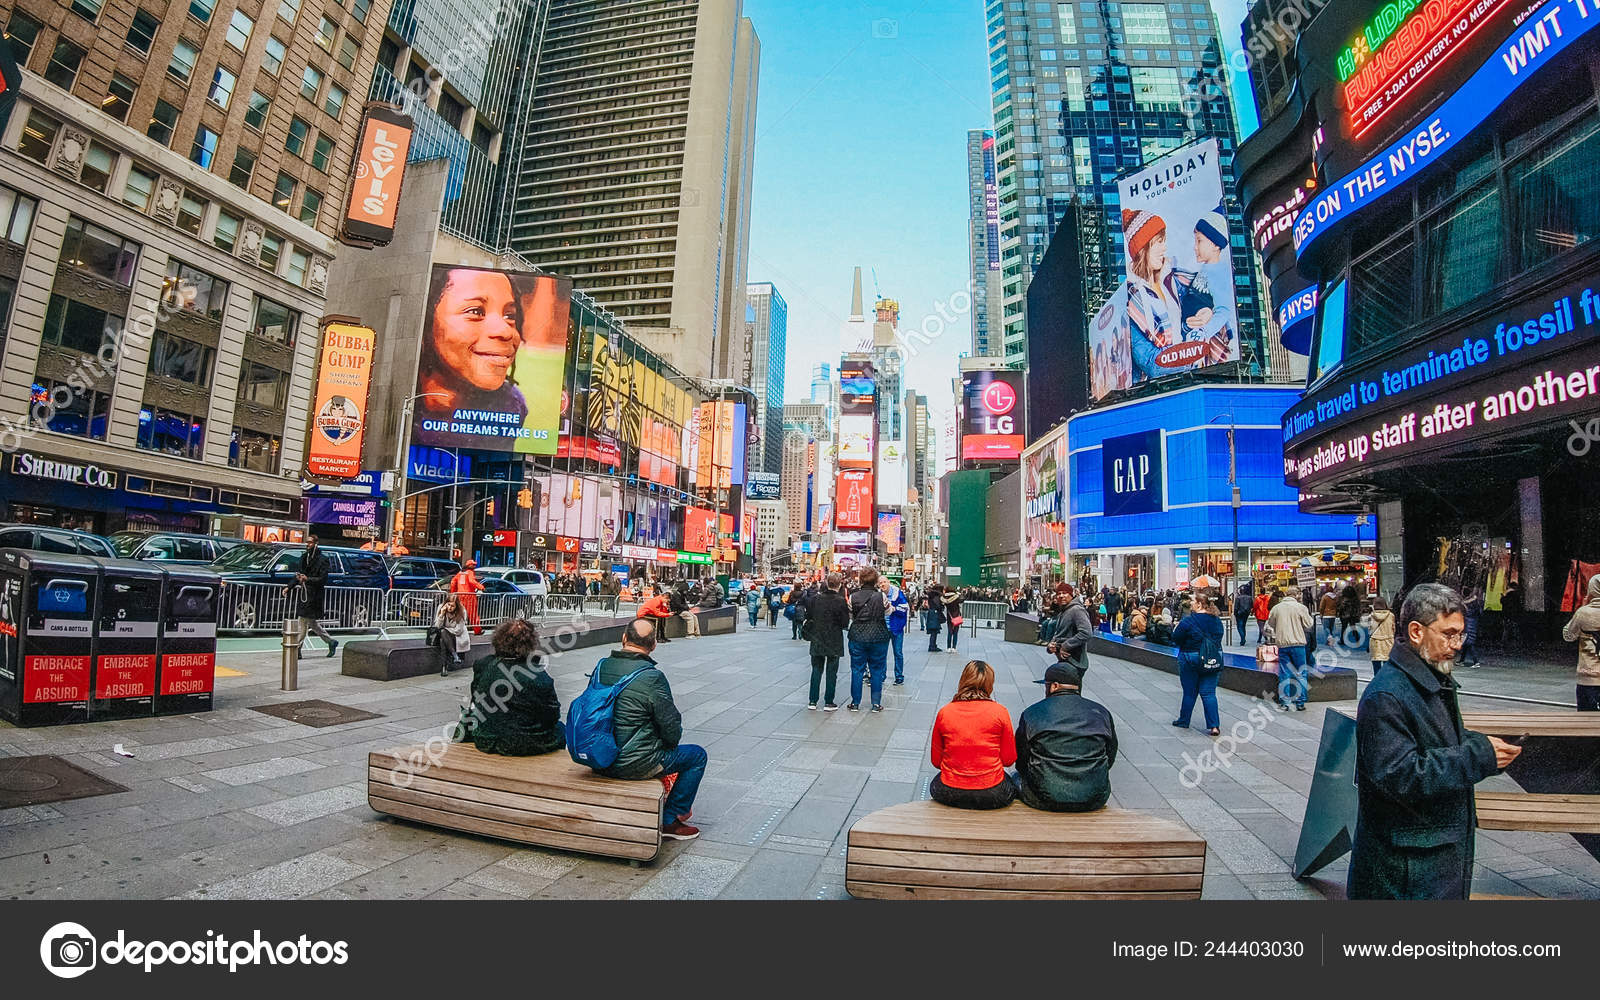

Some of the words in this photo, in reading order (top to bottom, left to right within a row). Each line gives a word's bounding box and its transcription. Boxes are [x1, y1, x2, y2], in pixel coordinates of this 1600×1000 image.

[1501, 6, 1562, 76] WMT
[1363, 97, 1384, 122] FREE
[1385, 74, 1409, 101] 2-DAY
[1409, 35, 1453, 78] DELIVERY.
[1452, 19, 1468, 39] NO
[1129, 152, 1208, 198] HOLIDAY
[1317, 190, 1341, 223] ON
[1343, 162, 1387, 204] THE
[1389, 118, 1451, 179] NYSE.
[1146, 188, 1167, 201] YOUR
[1177, 176, 1193, 191] OUT
[327, 331, 370, 351] BUBBA
[328, 350, 366, 369] GUMP
[1160, 352, 1178, 365] OLD
[1179, 344, 1204, 361] NAVY
[1293, 408, 1315, 435] time
[1317, 384, 1357, 423] travel
[1359, 381, 1378, 405] to
[1382, 336, 1489, 395] terminate
[1494, 296, 1575, 355] fossil
[318, 417, 340, 427] BUBBA
[453, 408, 520, 424] ANYWHERE
[423, 420, 449, 432] OUR
[450, 422, 500, 436] DREAMS
[501, 426, 530, 438] TAKE
[533, 429, 548, 440] US
[985, 416, 1014, 435] LG
[1313, 441, 1347, 471] shake
[1348, 435, 1369, 461] up
[1371, 412, 1416, 452] staff
[1421, 399, 1477, 438] after
[20, 453, 82, 482] SHRIMP
[311, 456, 358, 467] RESTAURANT
[318, 465, 350, 473] MARKET
[1113, 453, 1149, 494] GAP
[333, 502, 355, 513] CANNIBAL
[1027, 498, 1037, 518] OLD
[1037, 491, 1056, 516] NAVY
[339, 515, 353, 525] STATE
[33, 657, 83, 671] EMBRACE
[103, 656, 149, 669] EMBRACE
[168, 655, 208, 667] EMBRACE
[49, 673, 64, 682] THE
[118, 671, 131, 680] THE
[181, 669, 192, 677] THE
[35, 686, 78, 701] ABSURD
[105, 682, 144, 697] ABSURD
[169, 680, 204, 693] ABSURD
